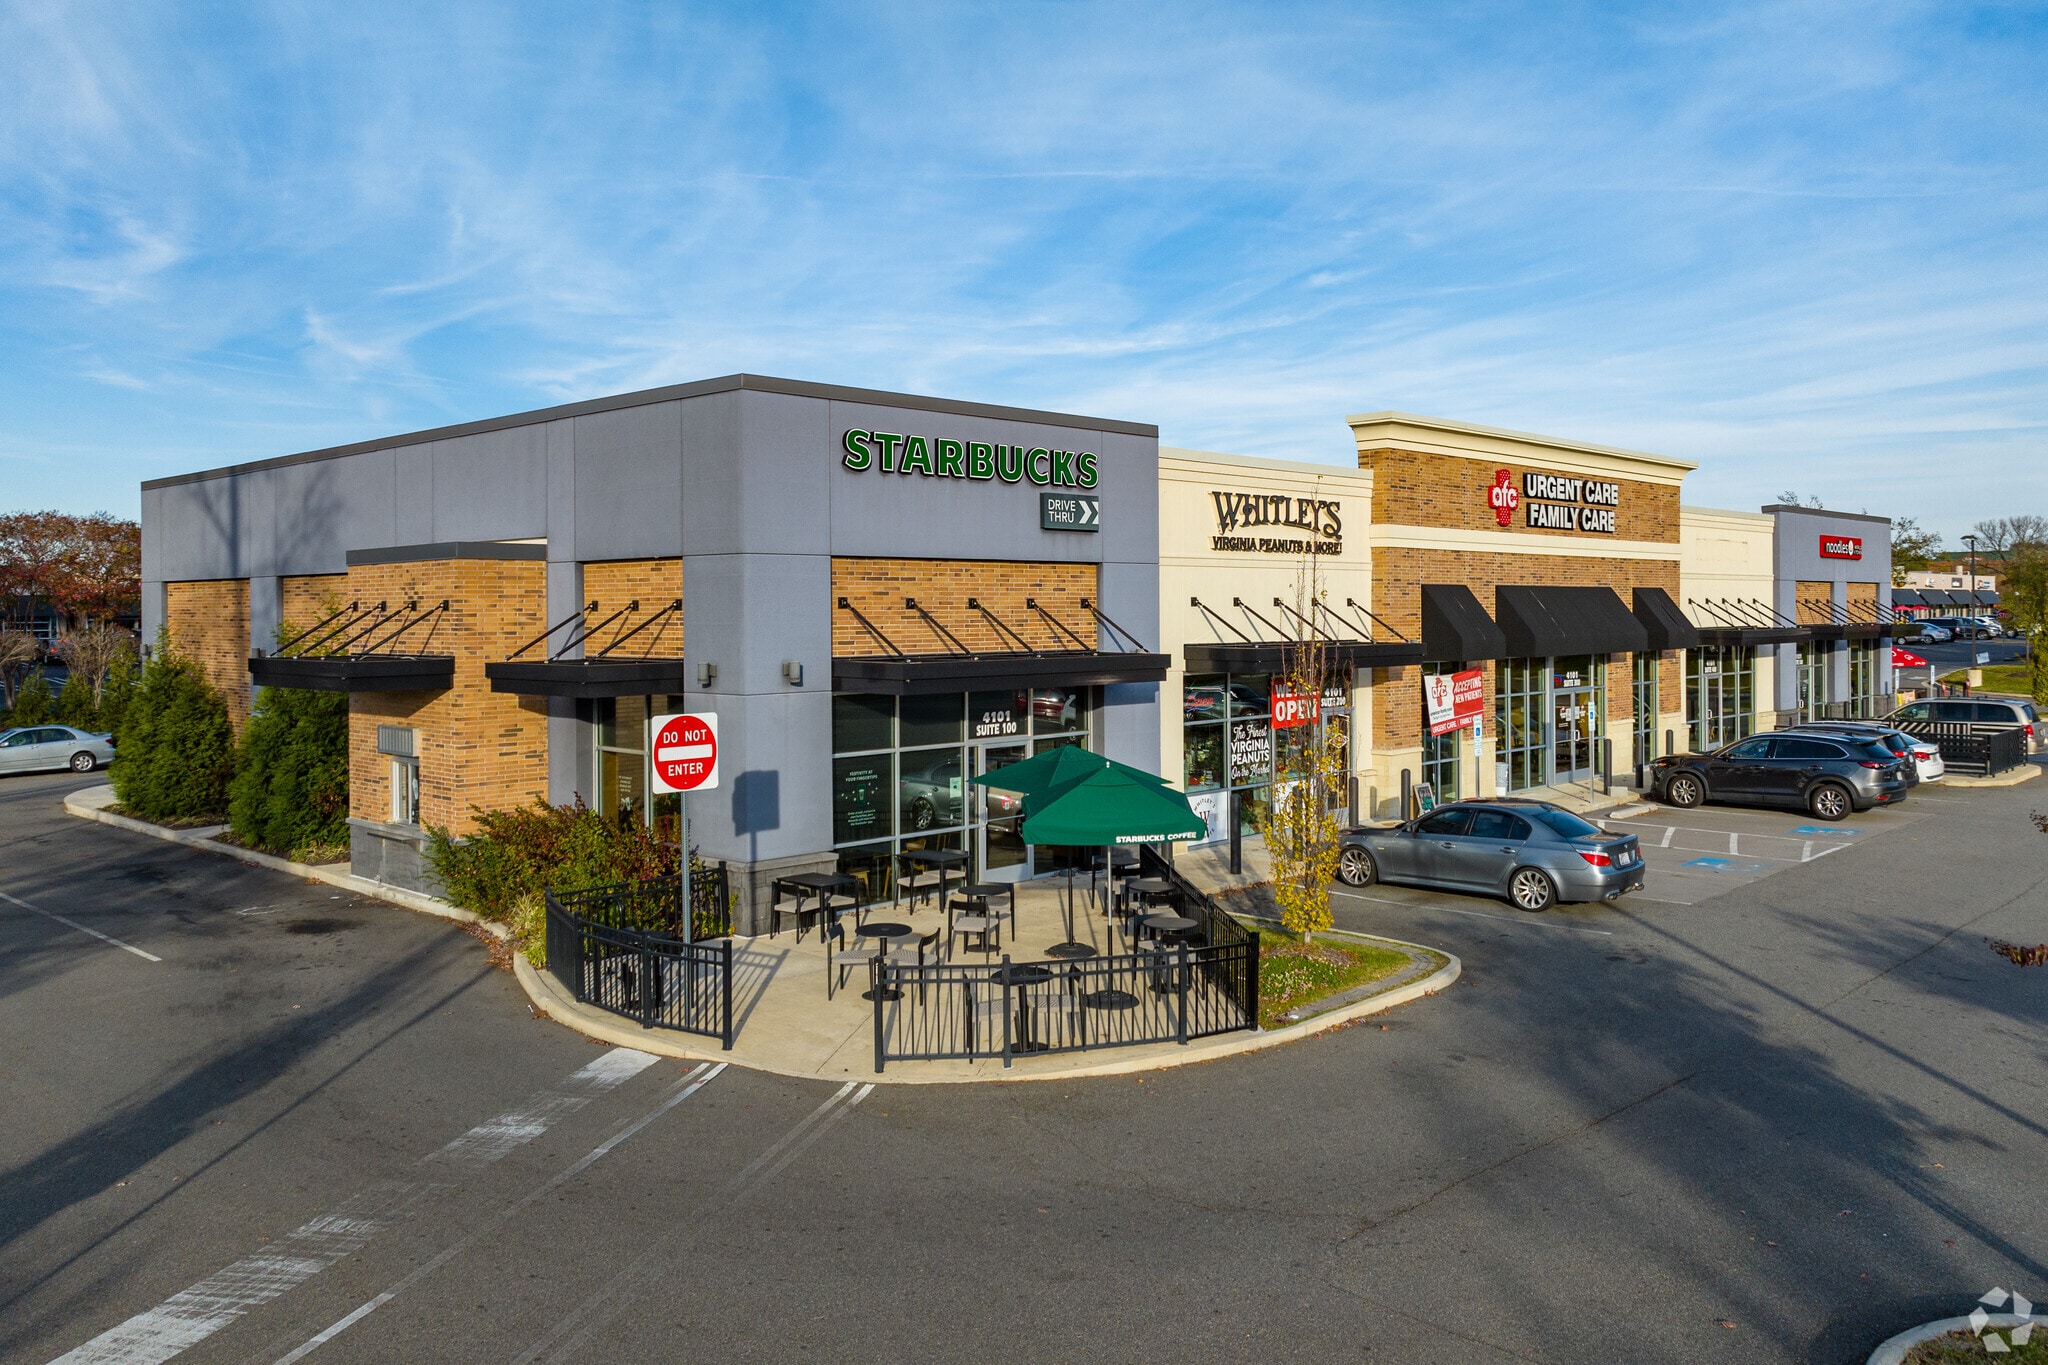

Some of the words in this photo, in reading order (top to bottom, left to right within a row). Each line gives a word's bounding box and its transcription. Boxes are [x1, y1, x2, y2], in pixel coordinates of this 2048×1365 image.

[844, 428, 1099, 489] STARBUCKS
[1492, 480, 1517, 507] afc
[1526, 474, 1583, 500] URGENT
[1585, 481, 1618, 505] CARE
[1048, 499, 1076, 511] DRIVE
[1048, 511, 1074, 523] THRU
[1211, 491, 1342, 540] WHITLEY'S
[1530, 503, 1579, 529] FAMILY
[1581, 508, 1616, 532] CARE
[1212, 536, 1256, 551] VIRGINIA
[1259, 538, 1303, 554] PEANUTS
[1305, 541, 1312, 553] &
[1314, 541, 1342, 555] MORE!
[1825, 540, 1849, 554] noodles
[1275, 684, 1292, 698] WE
[1454, 676, 1482, 693] ACCEPTING
[1325, 688, 1343, 697] 4101
[983, 710, 1011, 723] 4101
[976, 724, 1000, 737] SUITE
[1002, 722, 1017, 734] 100
[1447, 721, 1457, 730] CARE
[663, 732, 678, 743] DO
[685, 729, 707, 742] NOT
[1233, 725, 1246, 742] The
[1246, 724, 1267, 740] Finest
[1231, 739, 1270, 753] VIRGINIA
[1232, 750, 1270, 765] PEANUTS
[668, 762, 703, 776] ENTER
[1116, 834, 1165, 843] STARBUCKS
[1167, 831, 1197, 840] COFFEE
